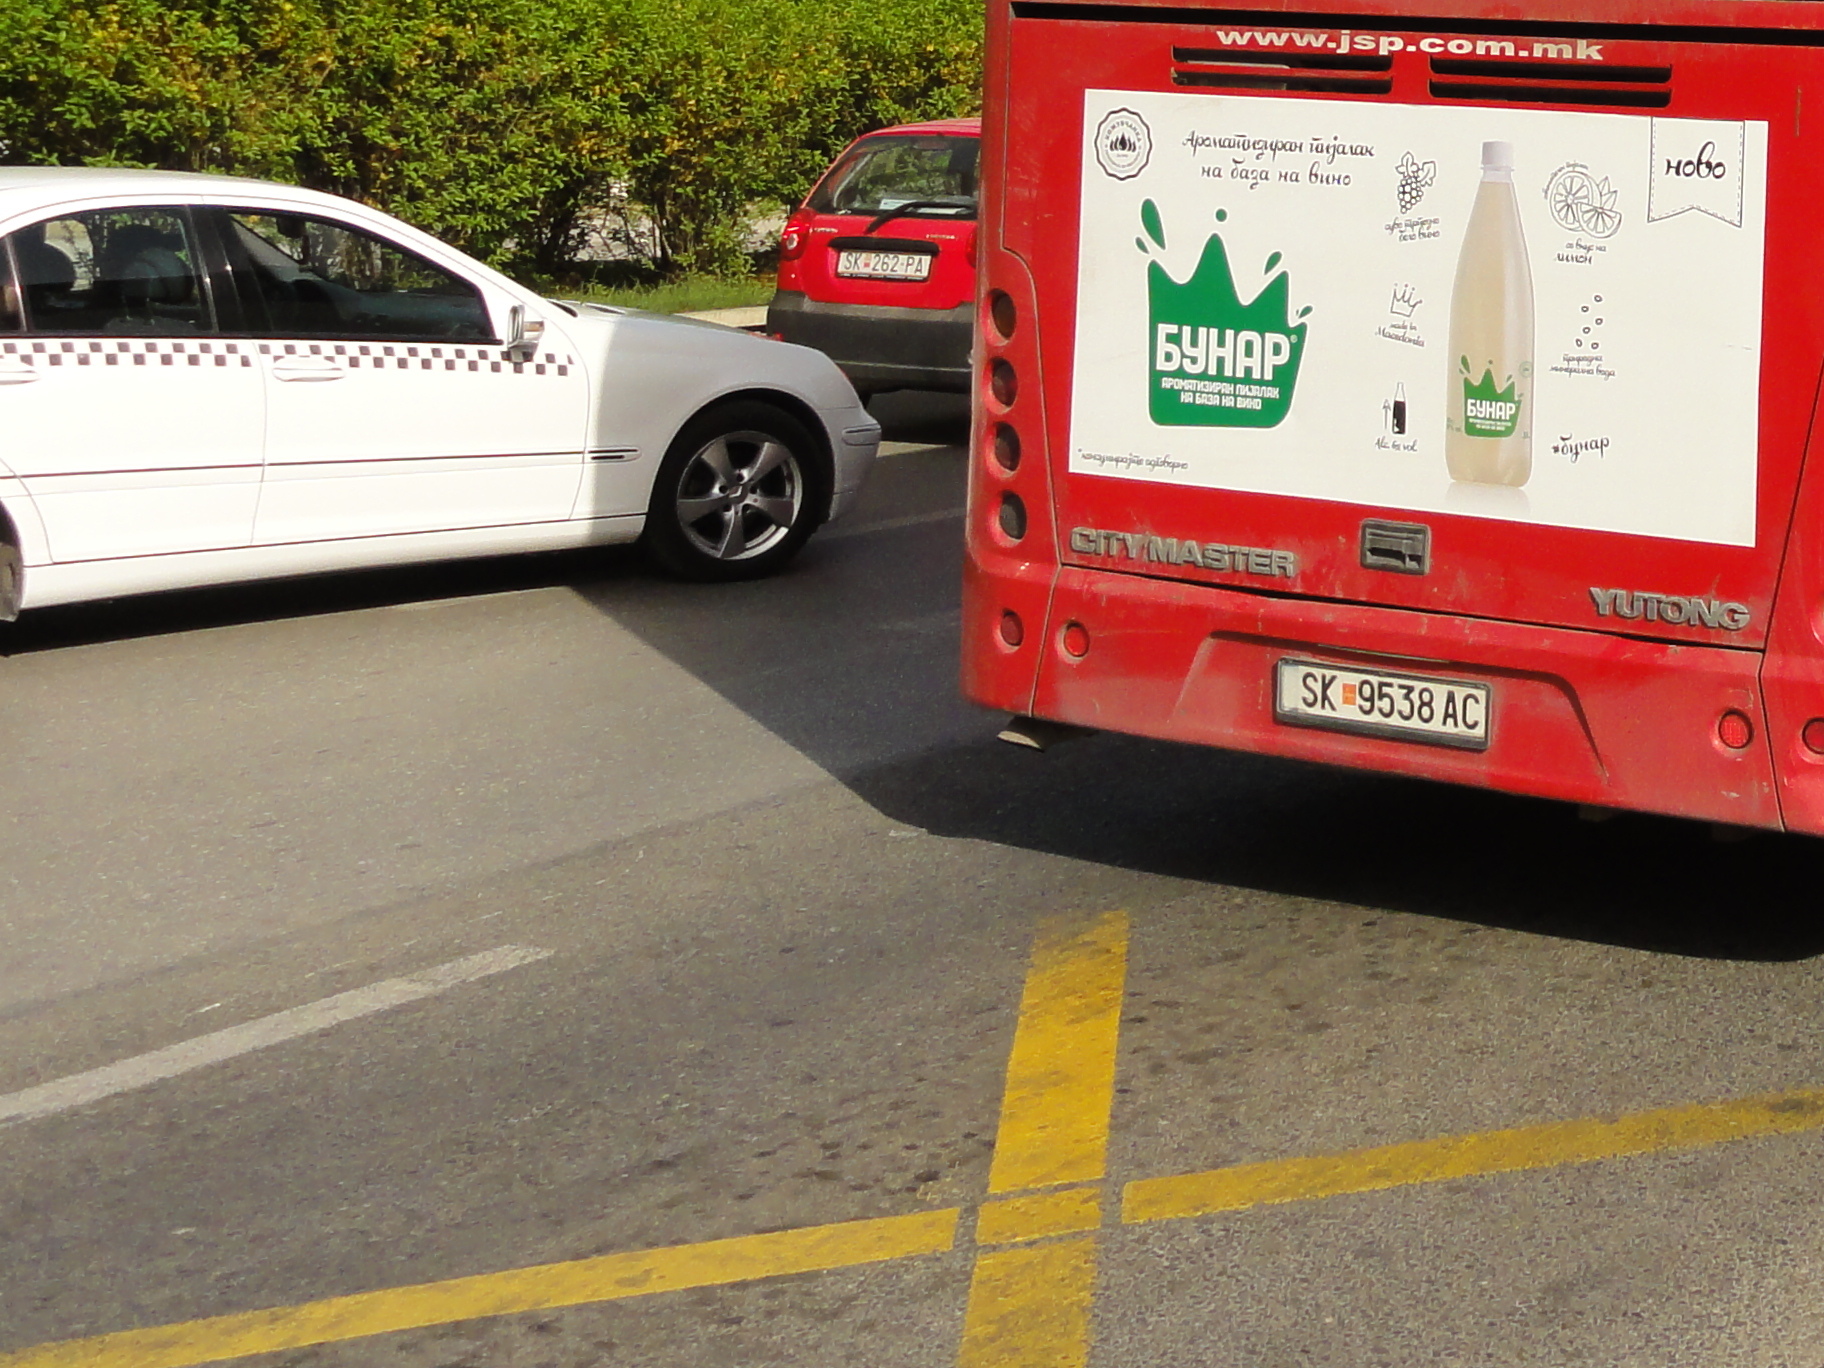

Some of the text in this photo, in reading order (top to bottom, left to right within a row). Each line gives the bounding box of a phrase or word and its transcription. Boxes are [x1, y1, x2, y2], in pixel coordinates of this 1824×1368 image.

[1216, 29, 1604, 61] www.jsp.com.mk
[1201, 157, 1352, 191] на база на вино
[1665, 141, 1727, 180] ново
[844, 252, 862, 271] SK
[1156, 323, 1291, 380] БУНАР
[1180, 391, 1262, 411] НА БАЗА НА ВИНО
[1466, 398, 1516, 420] БУНАР
[1589, 586, 1751, 631] YUTONG
[1301, 671, 1481, 730] SK 9538 AC
